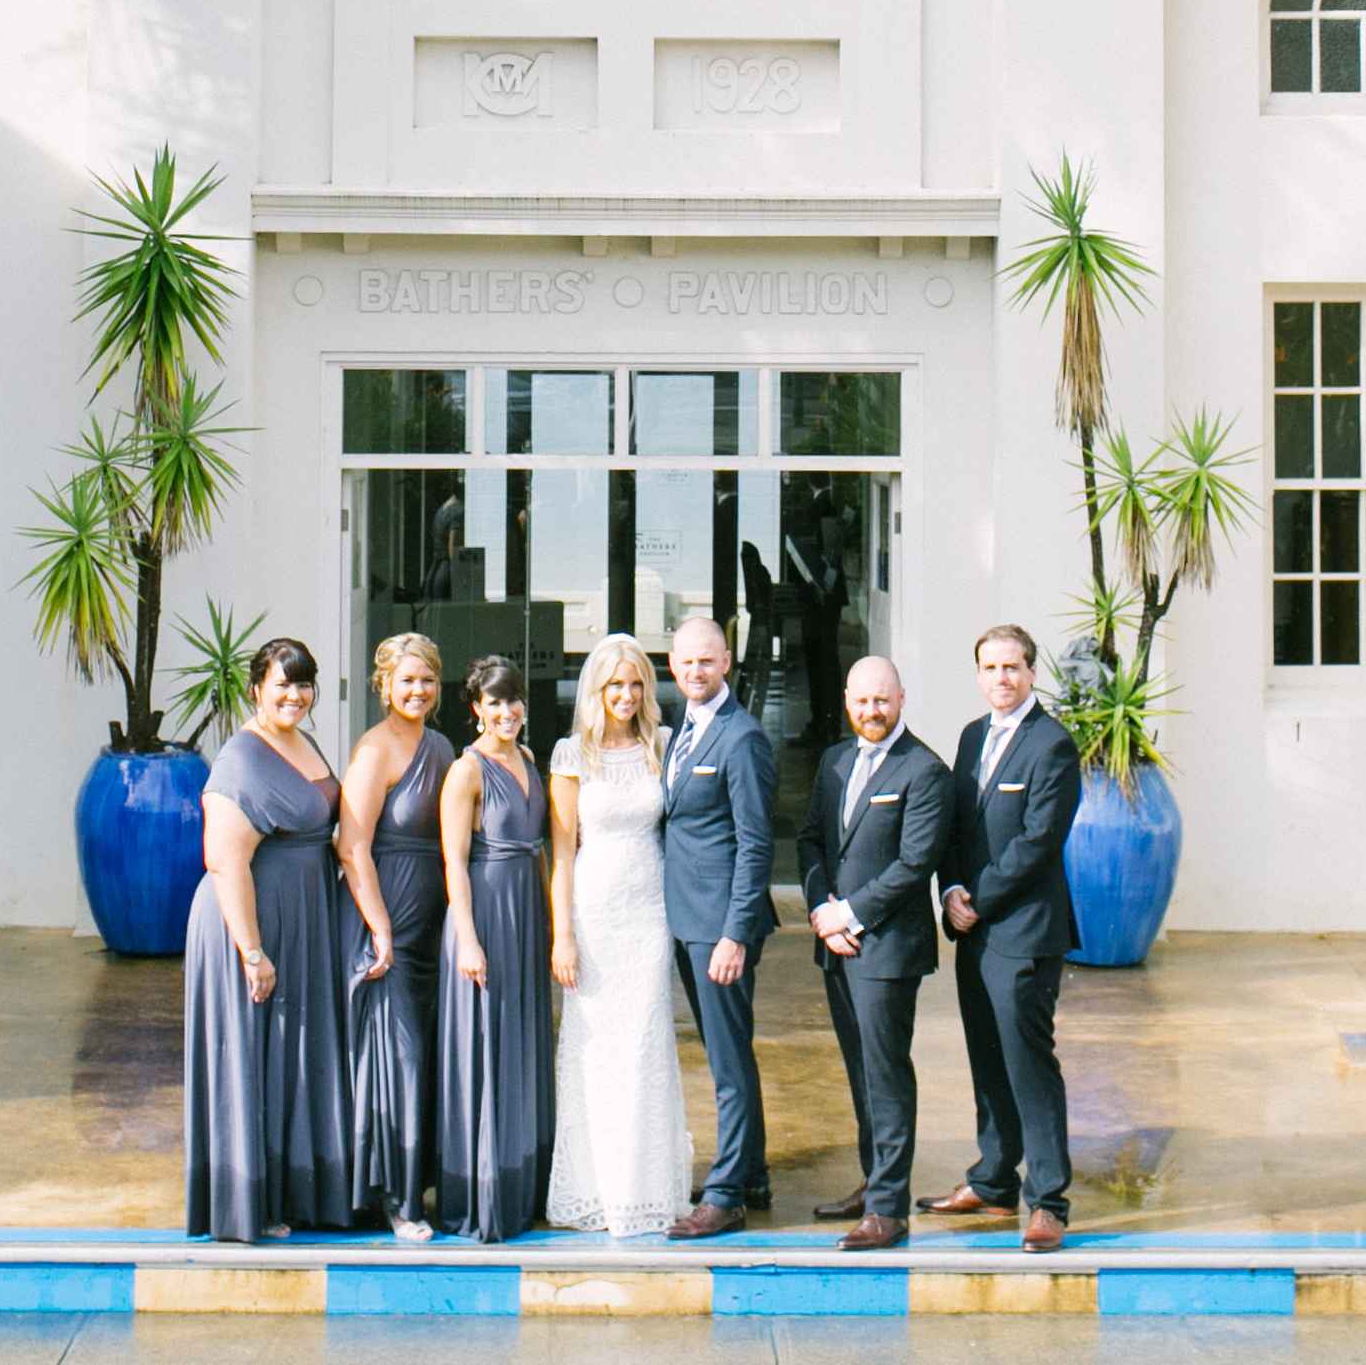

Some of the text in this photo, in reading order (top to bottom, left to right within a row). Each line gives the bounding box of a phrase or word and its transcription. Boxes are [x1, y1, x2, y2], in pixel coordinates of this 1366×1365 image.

[691, 55, 803, 115] 1928
[359, 268, 889, 315] BATHERS' PAVILION
